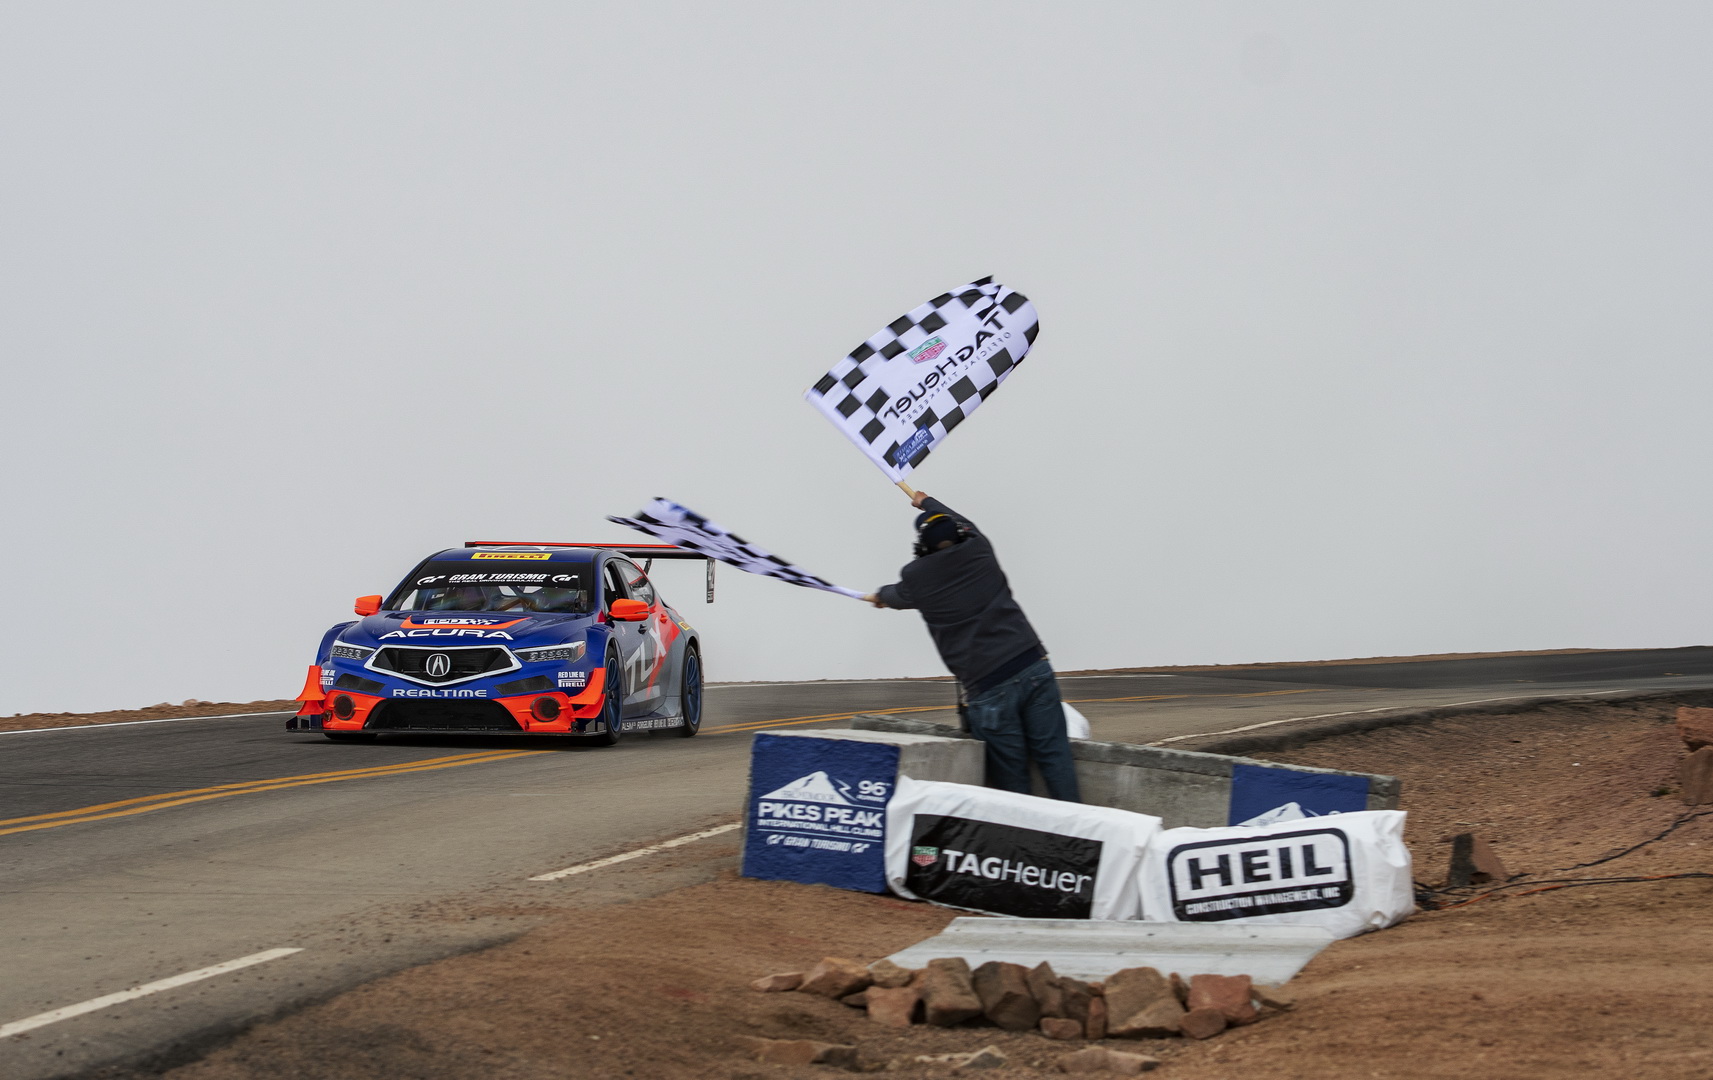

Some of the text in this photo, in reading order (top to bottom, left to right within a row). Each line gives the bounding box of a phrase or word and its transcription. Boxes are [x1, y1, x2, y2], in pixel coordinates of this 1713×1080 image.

[449, 573, 484, 581] GRAN
[488, 573, 547, 581] TURISMO
[380, 628, 514, 640] ACURA
[393, 689, 487, 697] REALTIME
[758, 802, 883, 828] PIKES PEAK
[1187, 844, 1333, 890] HEIL
